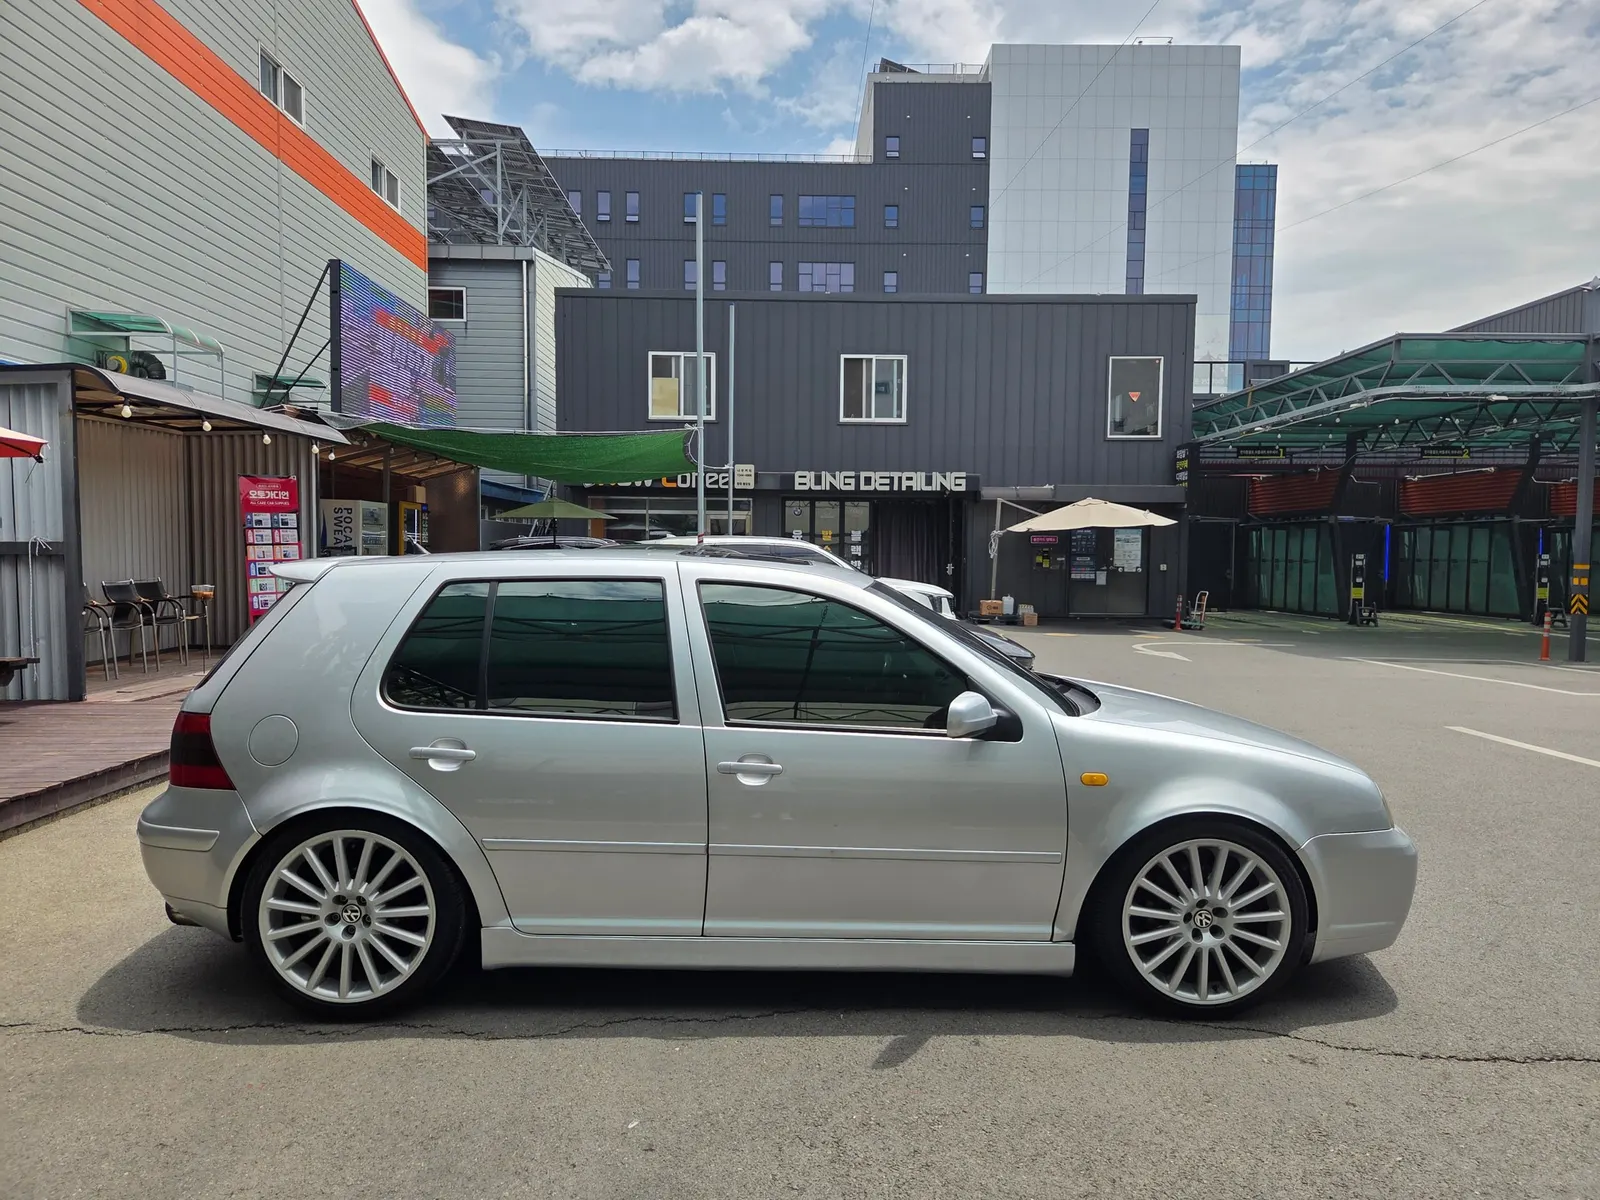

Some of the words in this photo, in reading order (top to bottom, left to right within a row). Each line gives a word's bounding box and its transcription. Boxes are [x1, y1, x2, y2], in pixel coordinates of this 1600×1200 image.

[1462, 448, 1470, 458] 2
[794, 471, 856, 491] BLING
[859, 471, 967, 491] DETAILING
[333, 507, 344, 546] SWEA
[343, 507, 353, 545] POCA
